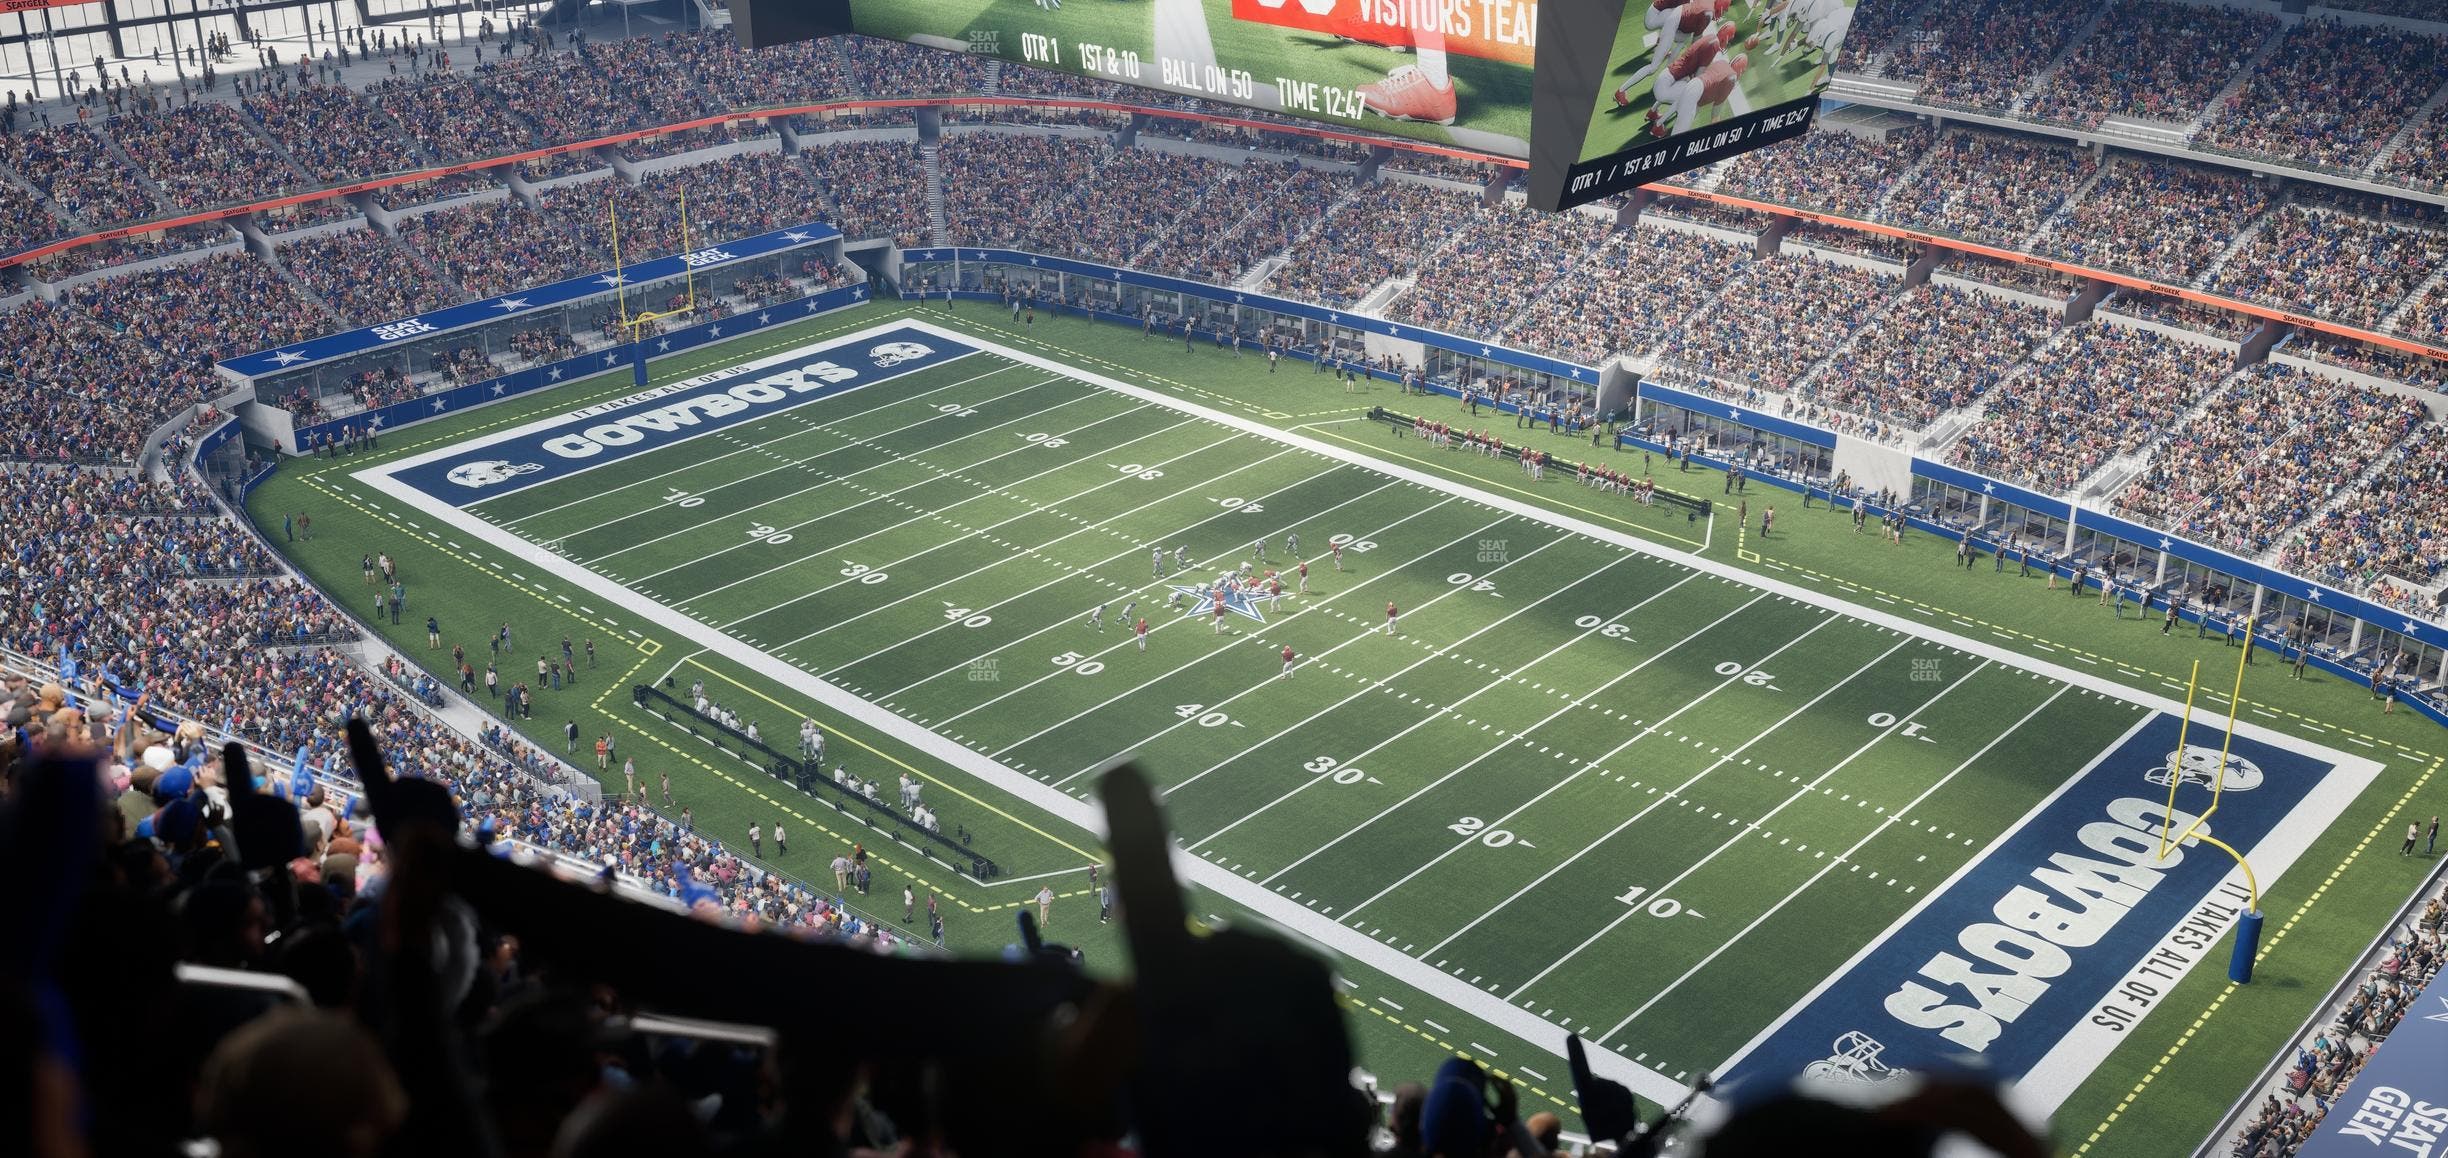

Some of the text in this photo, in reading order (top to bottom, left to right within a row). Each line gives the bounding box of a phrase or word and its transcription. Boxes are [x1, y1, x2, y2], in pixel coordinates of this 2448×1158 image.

[1021, 32, 1366, 120] QTR 1 1ST & 10 BALL ON 50 TIME 12:47
[1571, 172, 1595, 193] QTR
[1595, 170, 1602, 185] 1
[1623, 159, 1641, 177] 1ST
[1641, 156, 1651, 171] &
[1655, 151, 1667, 167] 10
[1686, 136, 1712, 158] BALL
[1712, 132, 1727, 149] ON
[1728, 128, 1743, 144] 50
[1761, 114, 1786, 133] TIME
[1906, 232, 1933, 243] SEATGEEK
[679, 248, 721, 261] SEAT
[689, 252, 739, 266] GEEK
[2024, 256, 2053, 268] SEATGEEK
[2149, 283, 2181, 296] SEATGEEK
[371, 318, 421, 334] SEAT
[380, 323, 440, 340] GEEK
[2283, 314, 2316, 328] SEATGEEK
[571, 365, 751, 419] IT TAKES ALL OF US
[541, 360, 859, 458] COWBOYS
[937, 403, 978, 418] 10
[1025, 432, 1070, 448] 20
[1118, 463, 1164, 481] 30
[663, 489, 706, 508] 10
[1220, 497, 1264, 514] 40
[748, 524, 794, 545] 20
[1328, 533, 1378, 553] 50
[840, 563, 889, 585] 30
[1446, 572, 1496, 592] 40
[943, 606, 992, 628] 40
[1574, 615, 1630, 638] 30
[1051, 651, 1105, 675] 50
[1714, 661, 1776, 686] 20
[1174, 703, 1229, 727] 40
[1867, 712, 1928, 737] 10
[1303, 756, 1364, 785] 30
[1447, 816, 1515, 847] 20
[1614, 885, 1682, 918] 10
[1884, 797, 2212, 1053] COWBOYS
[2091, 881, 2253, 1032] IT TAKES ALL OF US
[2337, 1086, 2411, 1147] GEEK
[2389, 1101, 2448, 1158] SEAT
